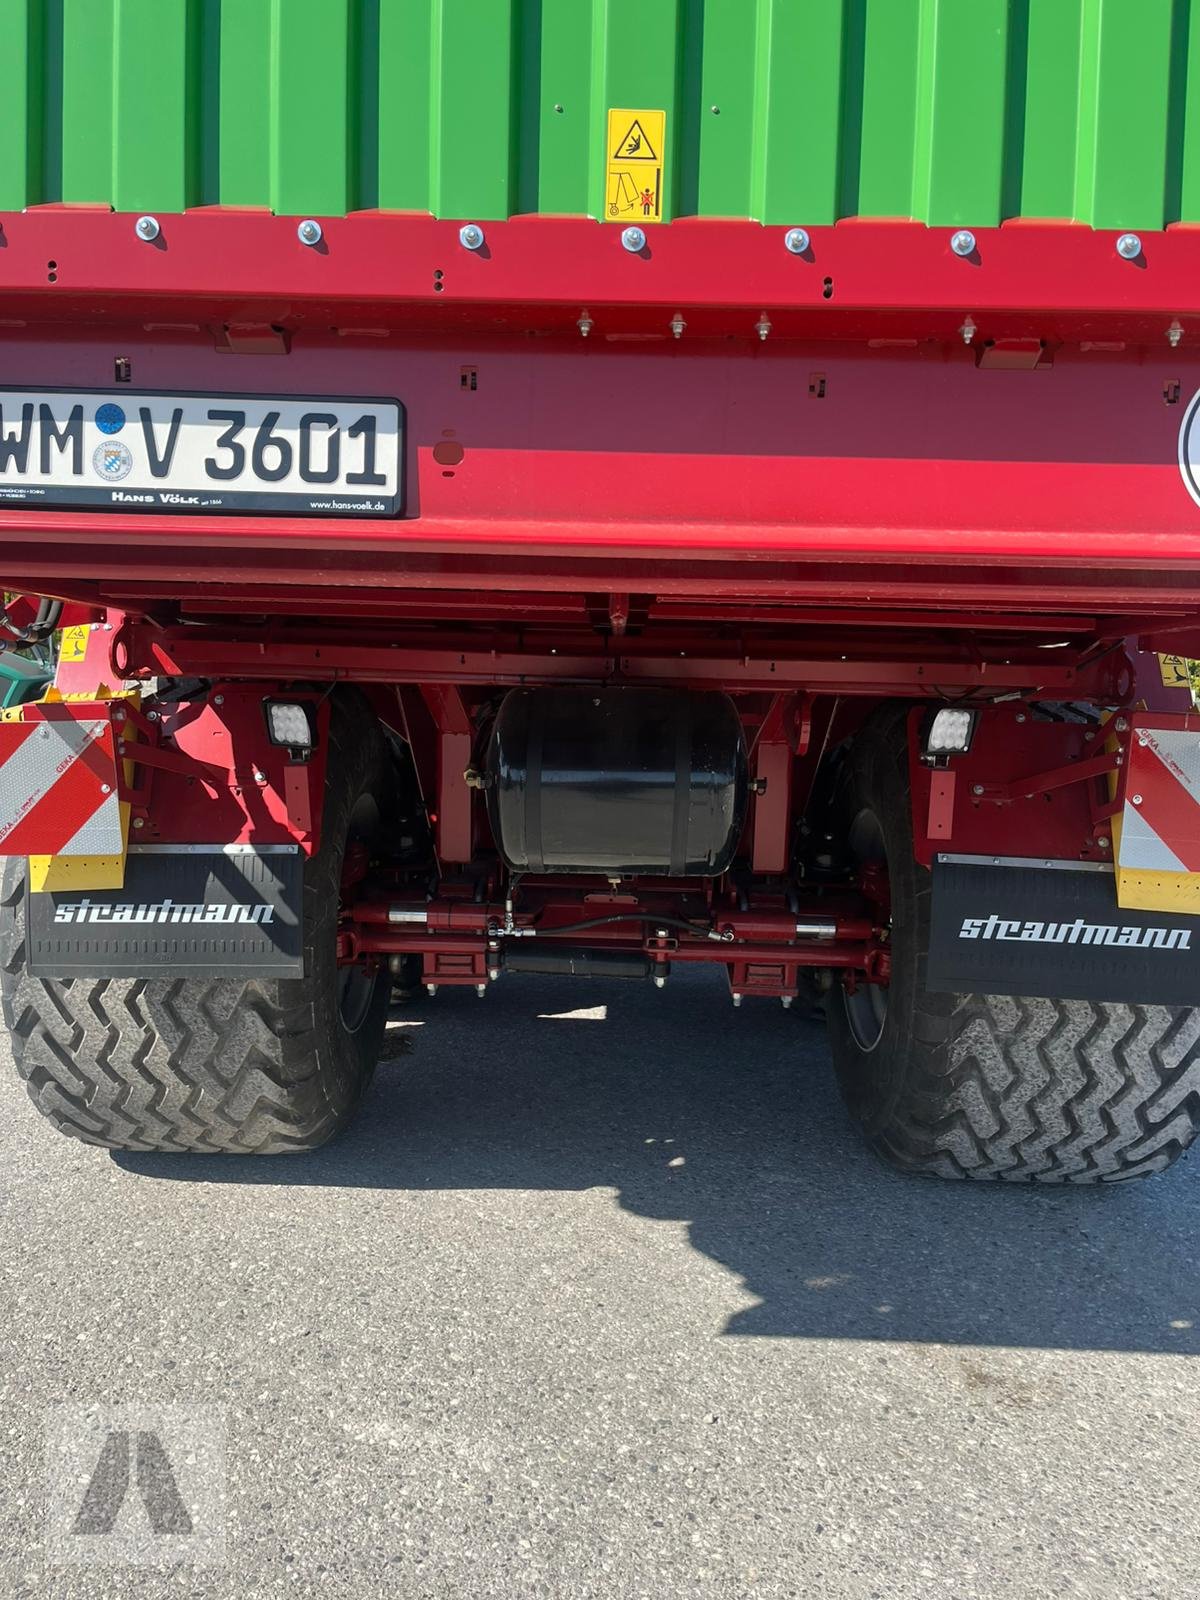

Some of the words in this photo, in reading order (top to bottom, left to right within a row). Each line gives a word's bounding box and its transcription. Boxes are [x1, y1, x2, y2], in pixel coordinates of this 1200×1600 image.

[138, 406, 183, 478] V
[204, 409, 387, 486] 3601
[55, 754, 76, 774] GEKA
[54, 899, 275, 924] strautmann
[958, 914, 1192, 950] strautmann
